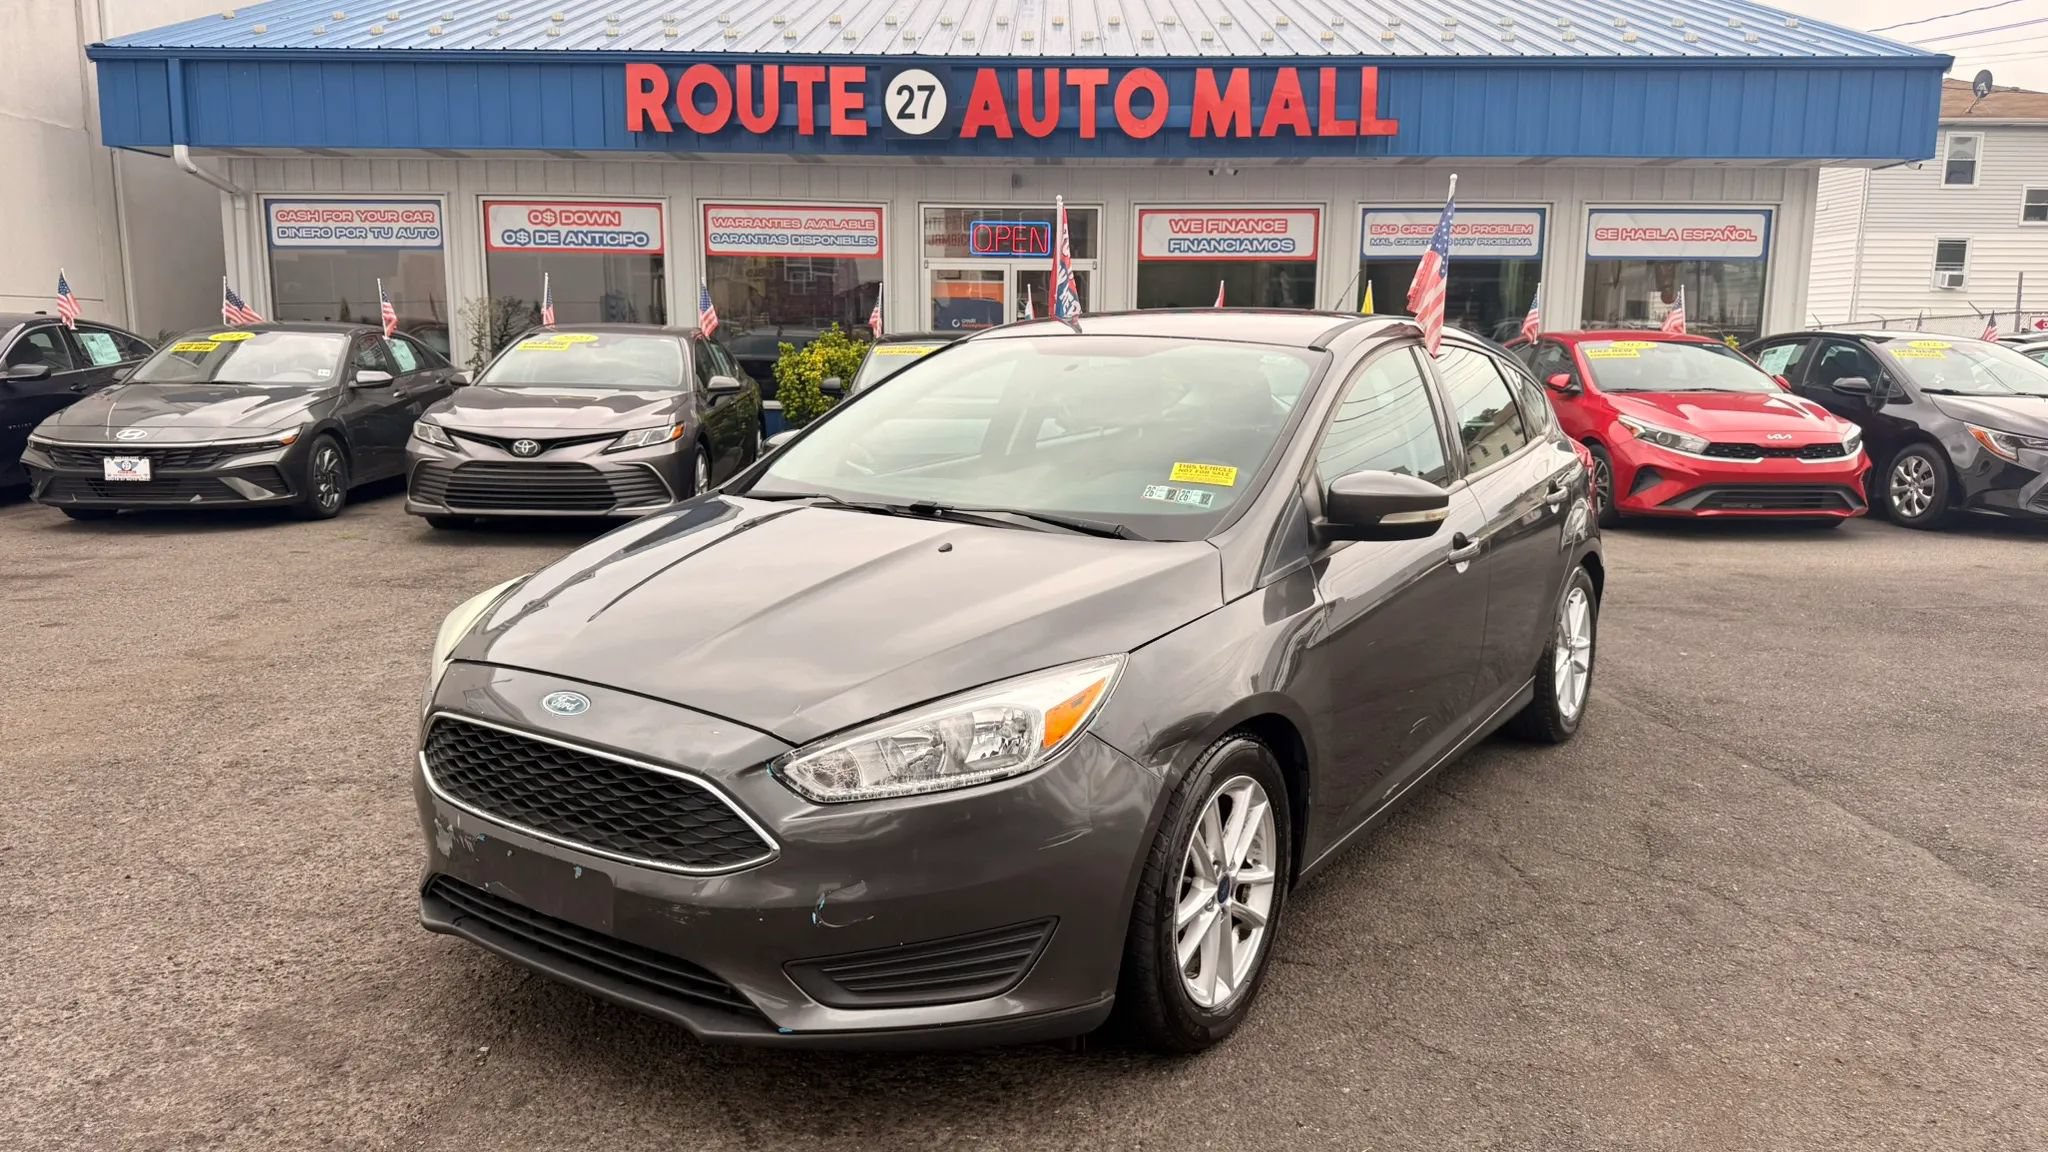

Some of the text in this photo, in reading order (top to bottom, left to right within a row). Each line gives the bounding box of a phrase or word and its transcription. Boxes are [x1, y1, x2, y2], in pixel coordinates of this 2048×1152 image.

[625, 63, 1398, 139] ROUTE 27 AUTO MALL
[276, 210, 435, 223] CASH FOR YOUR CAR
[561, 210, 621, 226] DOWN
[712, 217, 876, 230] WARRANTIES AVAILABLE
[1169, 219, 1287, 233] WE FINANCE
[1370, 224, 1398, 234] BAD
[1401, 224, 1435, 234] CRED
[1471, 224, 1533, 234] PROBLEM
[277, 227, 439, 239] DINERO POR TU AUTO
[533, 230, 561, 245] DE
[563, 230, 649, 247] ANTICIPO
[710, 233, 877, 246] GARANTIAS DISPONIBLES
[972, 223, 1050, 254] OPEN
[1595, 225, 1757, 241] SE HABLA ESPAÑOL
[1168, 238, 1295, 252] FINANCIAMOS
[1370, 238, 1393, 246] MAL
[1394, 238, 1431, 246] CREDIT
[1454, 238, 1476, 246] HAY
[1477, 238, 1532, 246] PROBLEMA
[1199, 464, 1233, 473] VEHICLE
[1145, 486, 1156, 497] 26
[1179, 490, 1190, 502] 26
[550, 695, 581, 711] Ford
